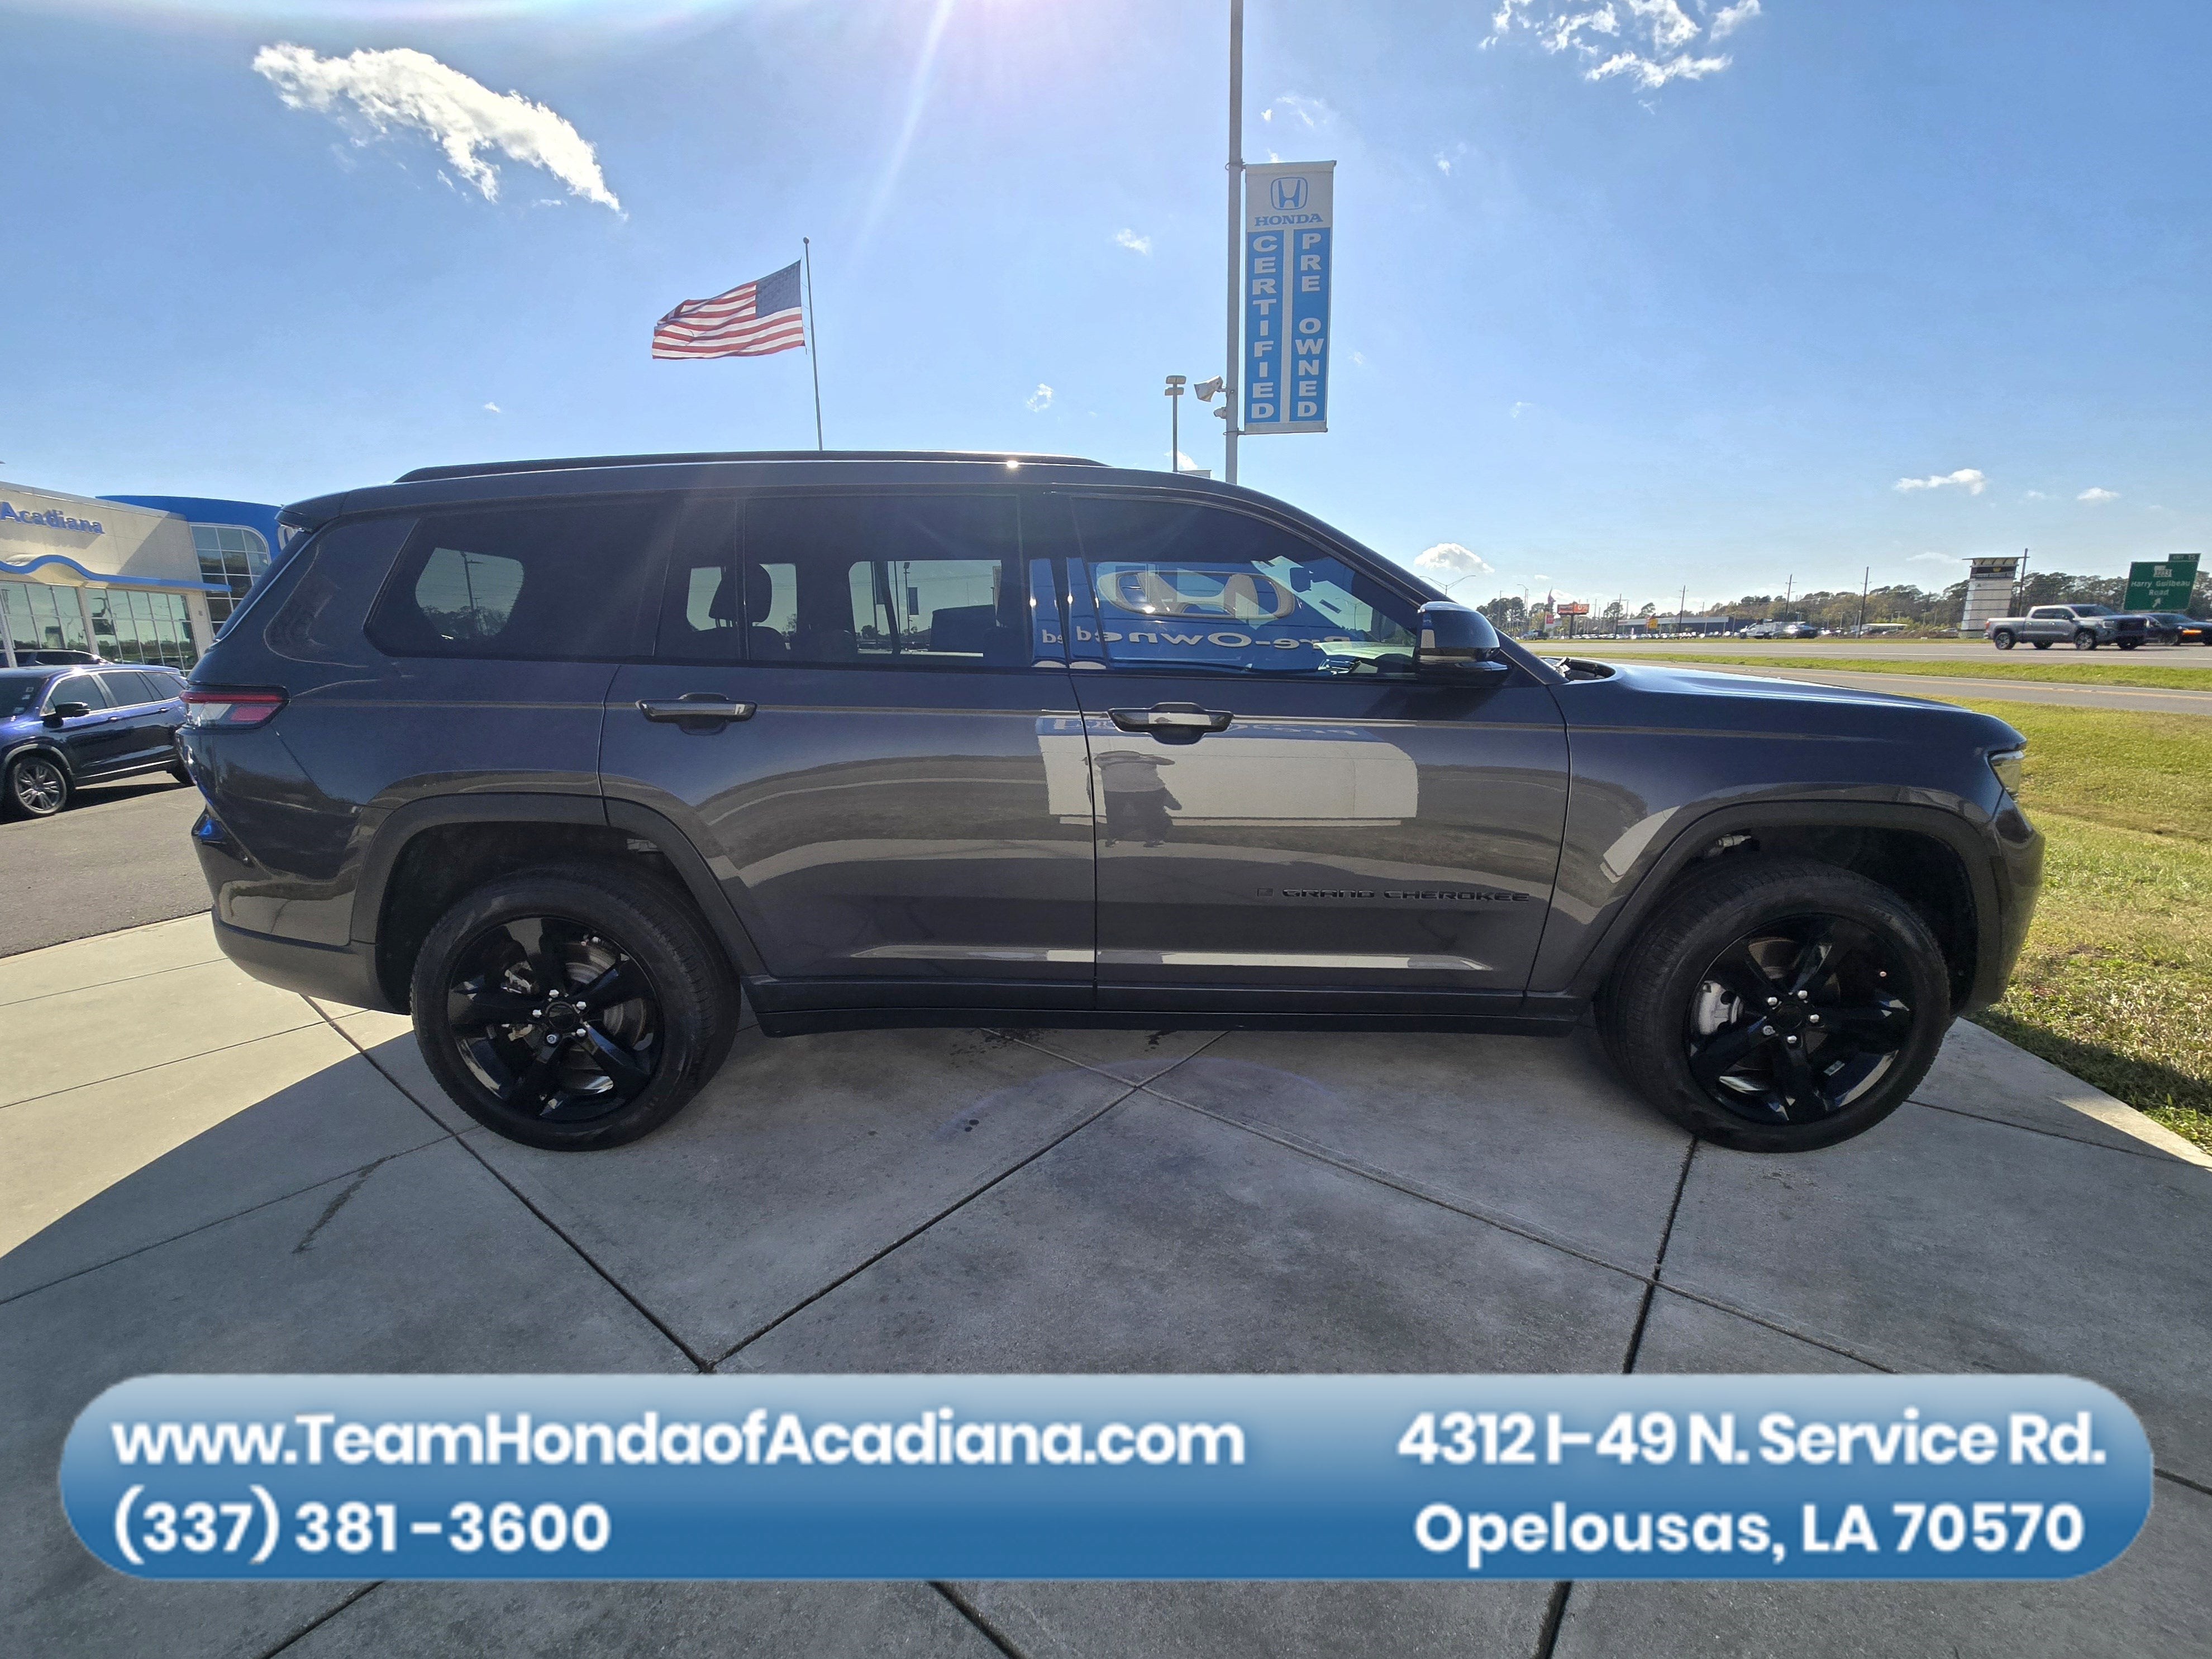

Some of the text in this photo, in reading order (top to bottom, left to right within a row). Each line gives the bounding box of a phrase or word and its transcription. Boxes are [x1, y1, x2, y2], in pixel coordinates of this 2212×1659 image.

[1255, 213, 1323, 227] HONDA
[1300, 232, 1322, 292] PRE
[1251, 235, 1278, 419] CERTIFIED
[1295, 317, 1324, 418] OWNED
[0, 502, 106, 535] Acadiana
[1283, 888, 1530, 902] GRAND CHEROKEE
